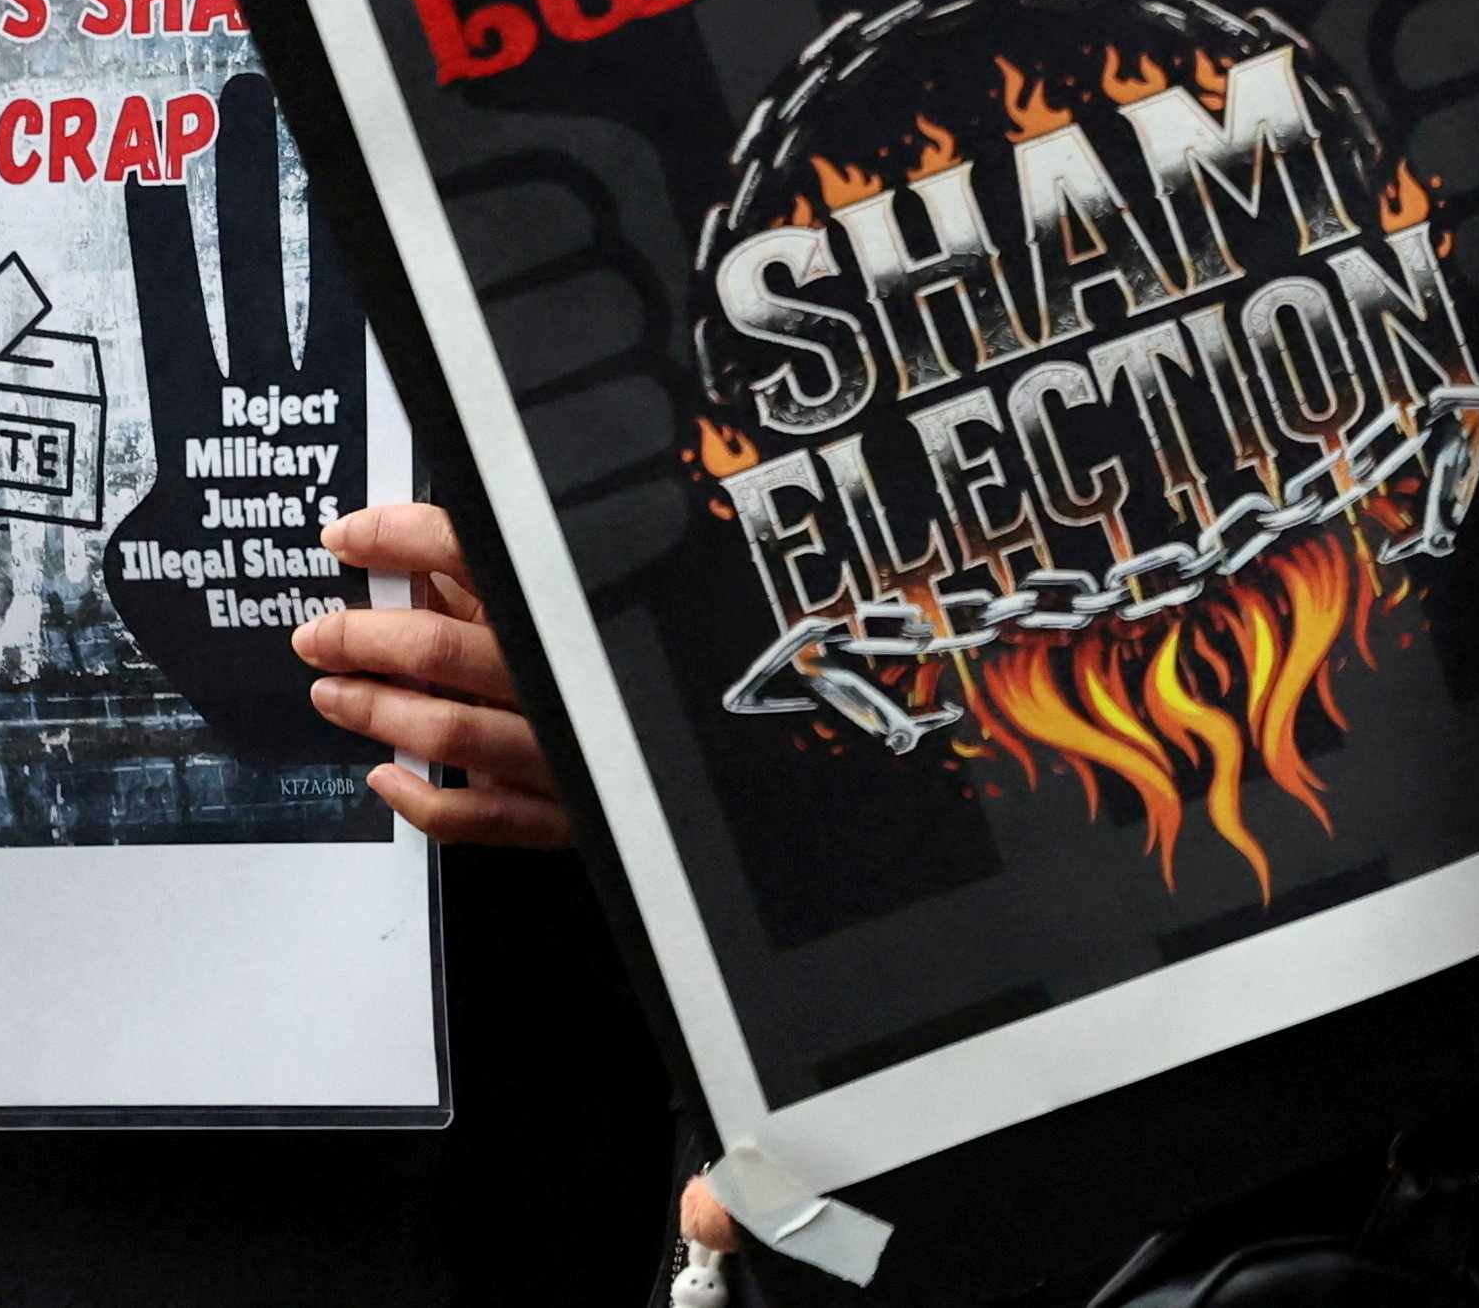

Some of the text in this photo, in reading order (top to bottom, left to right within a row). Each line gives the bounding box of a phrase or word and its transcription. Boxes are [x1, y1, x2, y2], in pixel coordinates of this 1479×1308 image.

[716, 44, 1360, 435] SHAM
[222, 385, 340, 436] Reject
[185, 436, 340, 485] Military
[201, 486, 340, 530] Junta's
[119, 538, 341, 589] Illegal Sham
